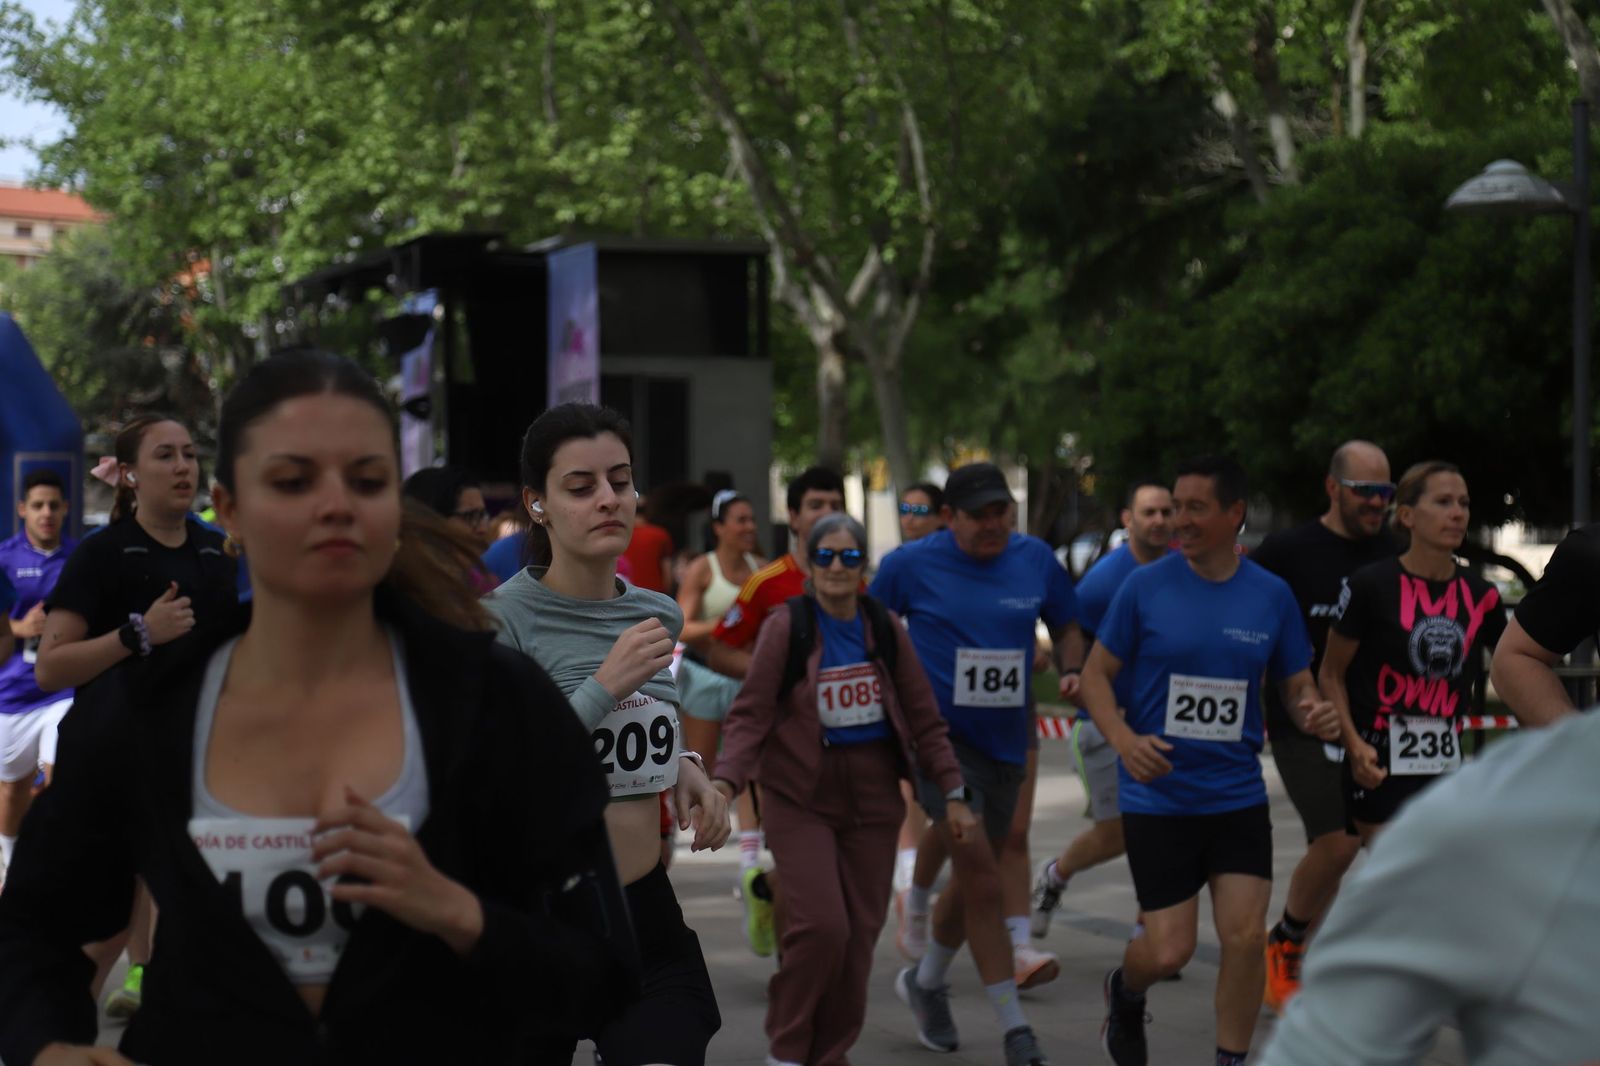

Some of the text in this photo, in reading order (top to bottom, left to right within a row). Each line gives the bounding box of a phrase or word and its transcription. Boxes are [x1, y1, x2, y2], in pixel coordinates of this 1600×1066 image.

[1400, 574, 1499, 660] MY
[964, 666, 1020, 693] 184
[1377, 663, 1460, 717] OWN
[1174, 695, 1239, 726] 203
[592, 715, 674, 774] 209
[1399, 732, 1456, 759] 238
[225, 835, 246, 849] DE
